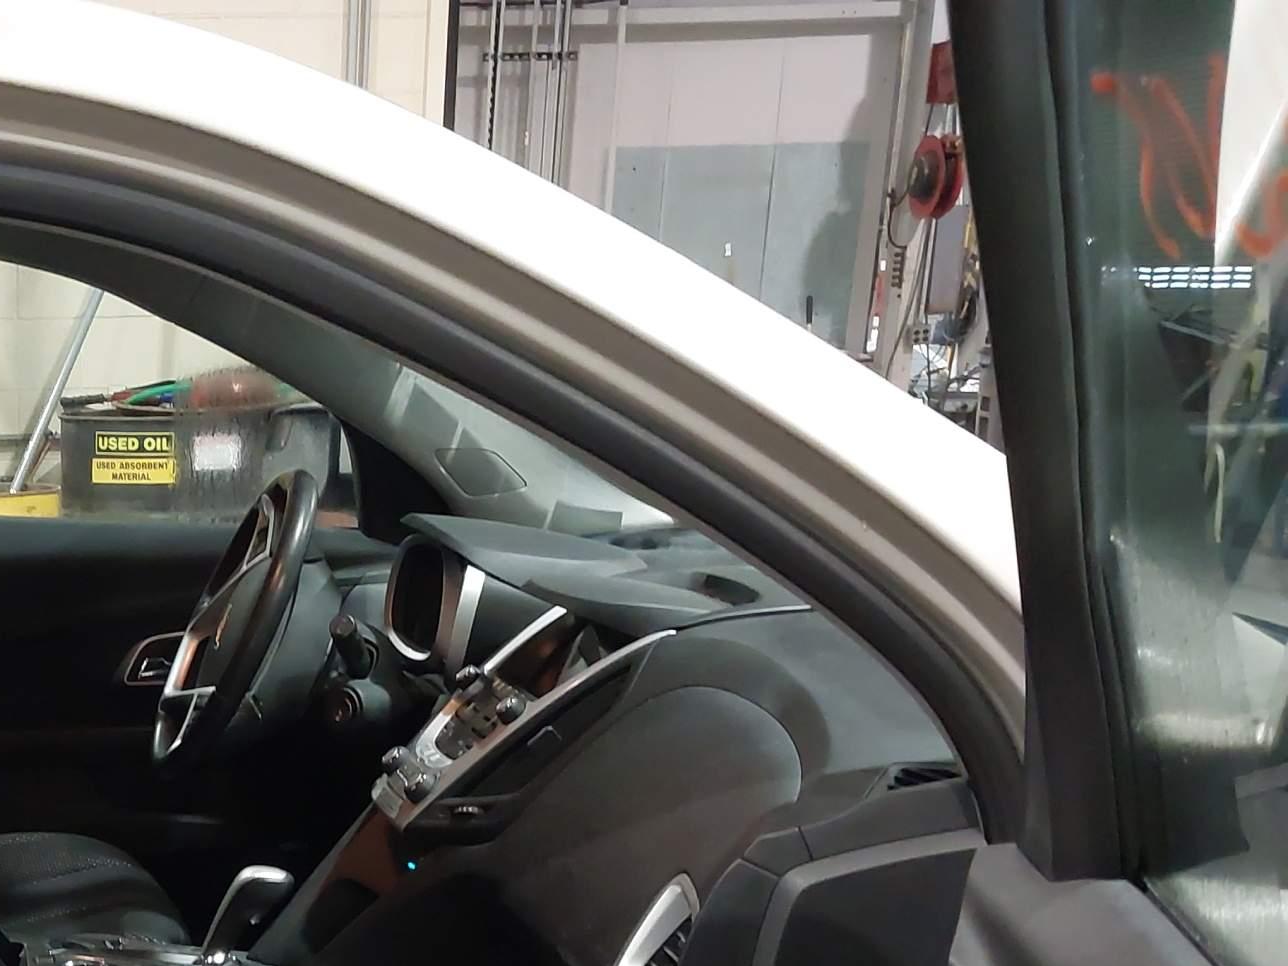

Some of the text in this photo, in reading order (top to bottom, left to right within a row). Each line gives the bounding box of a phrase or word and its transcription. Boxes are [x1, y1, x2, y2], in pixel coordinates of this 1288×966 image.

[98, 437, 170, 451] USED OIL
[96, 461, 169, 470] USED ABSORBENT
[111, 471, 152, 481] MATERIAL
